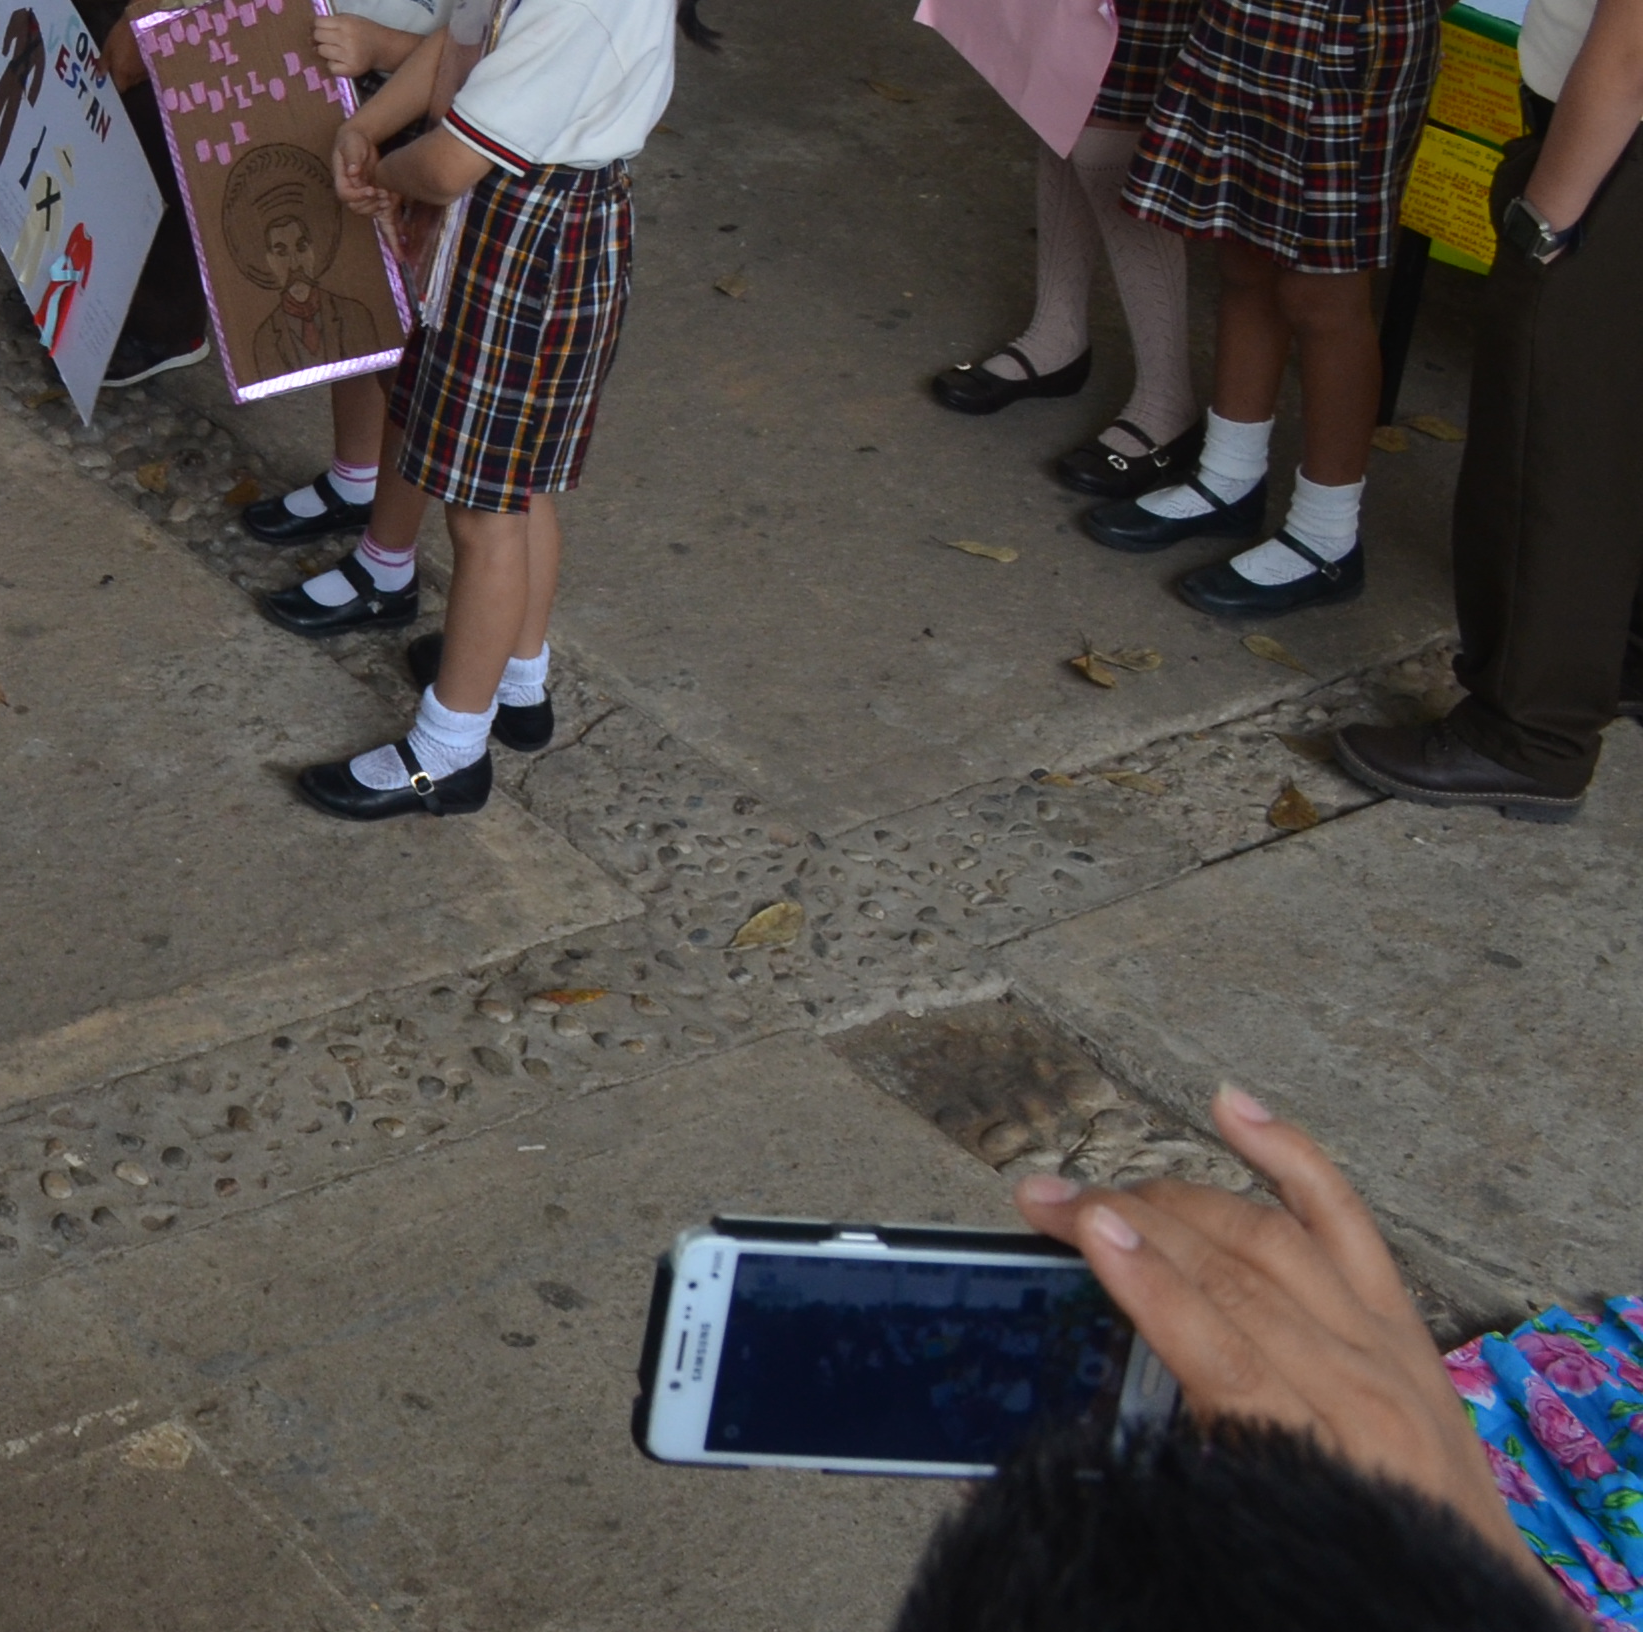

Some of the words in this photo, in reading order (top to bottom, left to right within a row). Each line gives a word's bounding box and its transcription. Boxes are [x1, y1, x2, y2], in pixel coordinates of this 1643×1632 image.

[65, 15, 108, 89] COMO
[208, 39, 239, 66] AL
[164, 71, 285, 114] CAUDILLO
[283, 52, 342, 104] DEL
[691, 1322, 712, 1382] SAMSUNG
